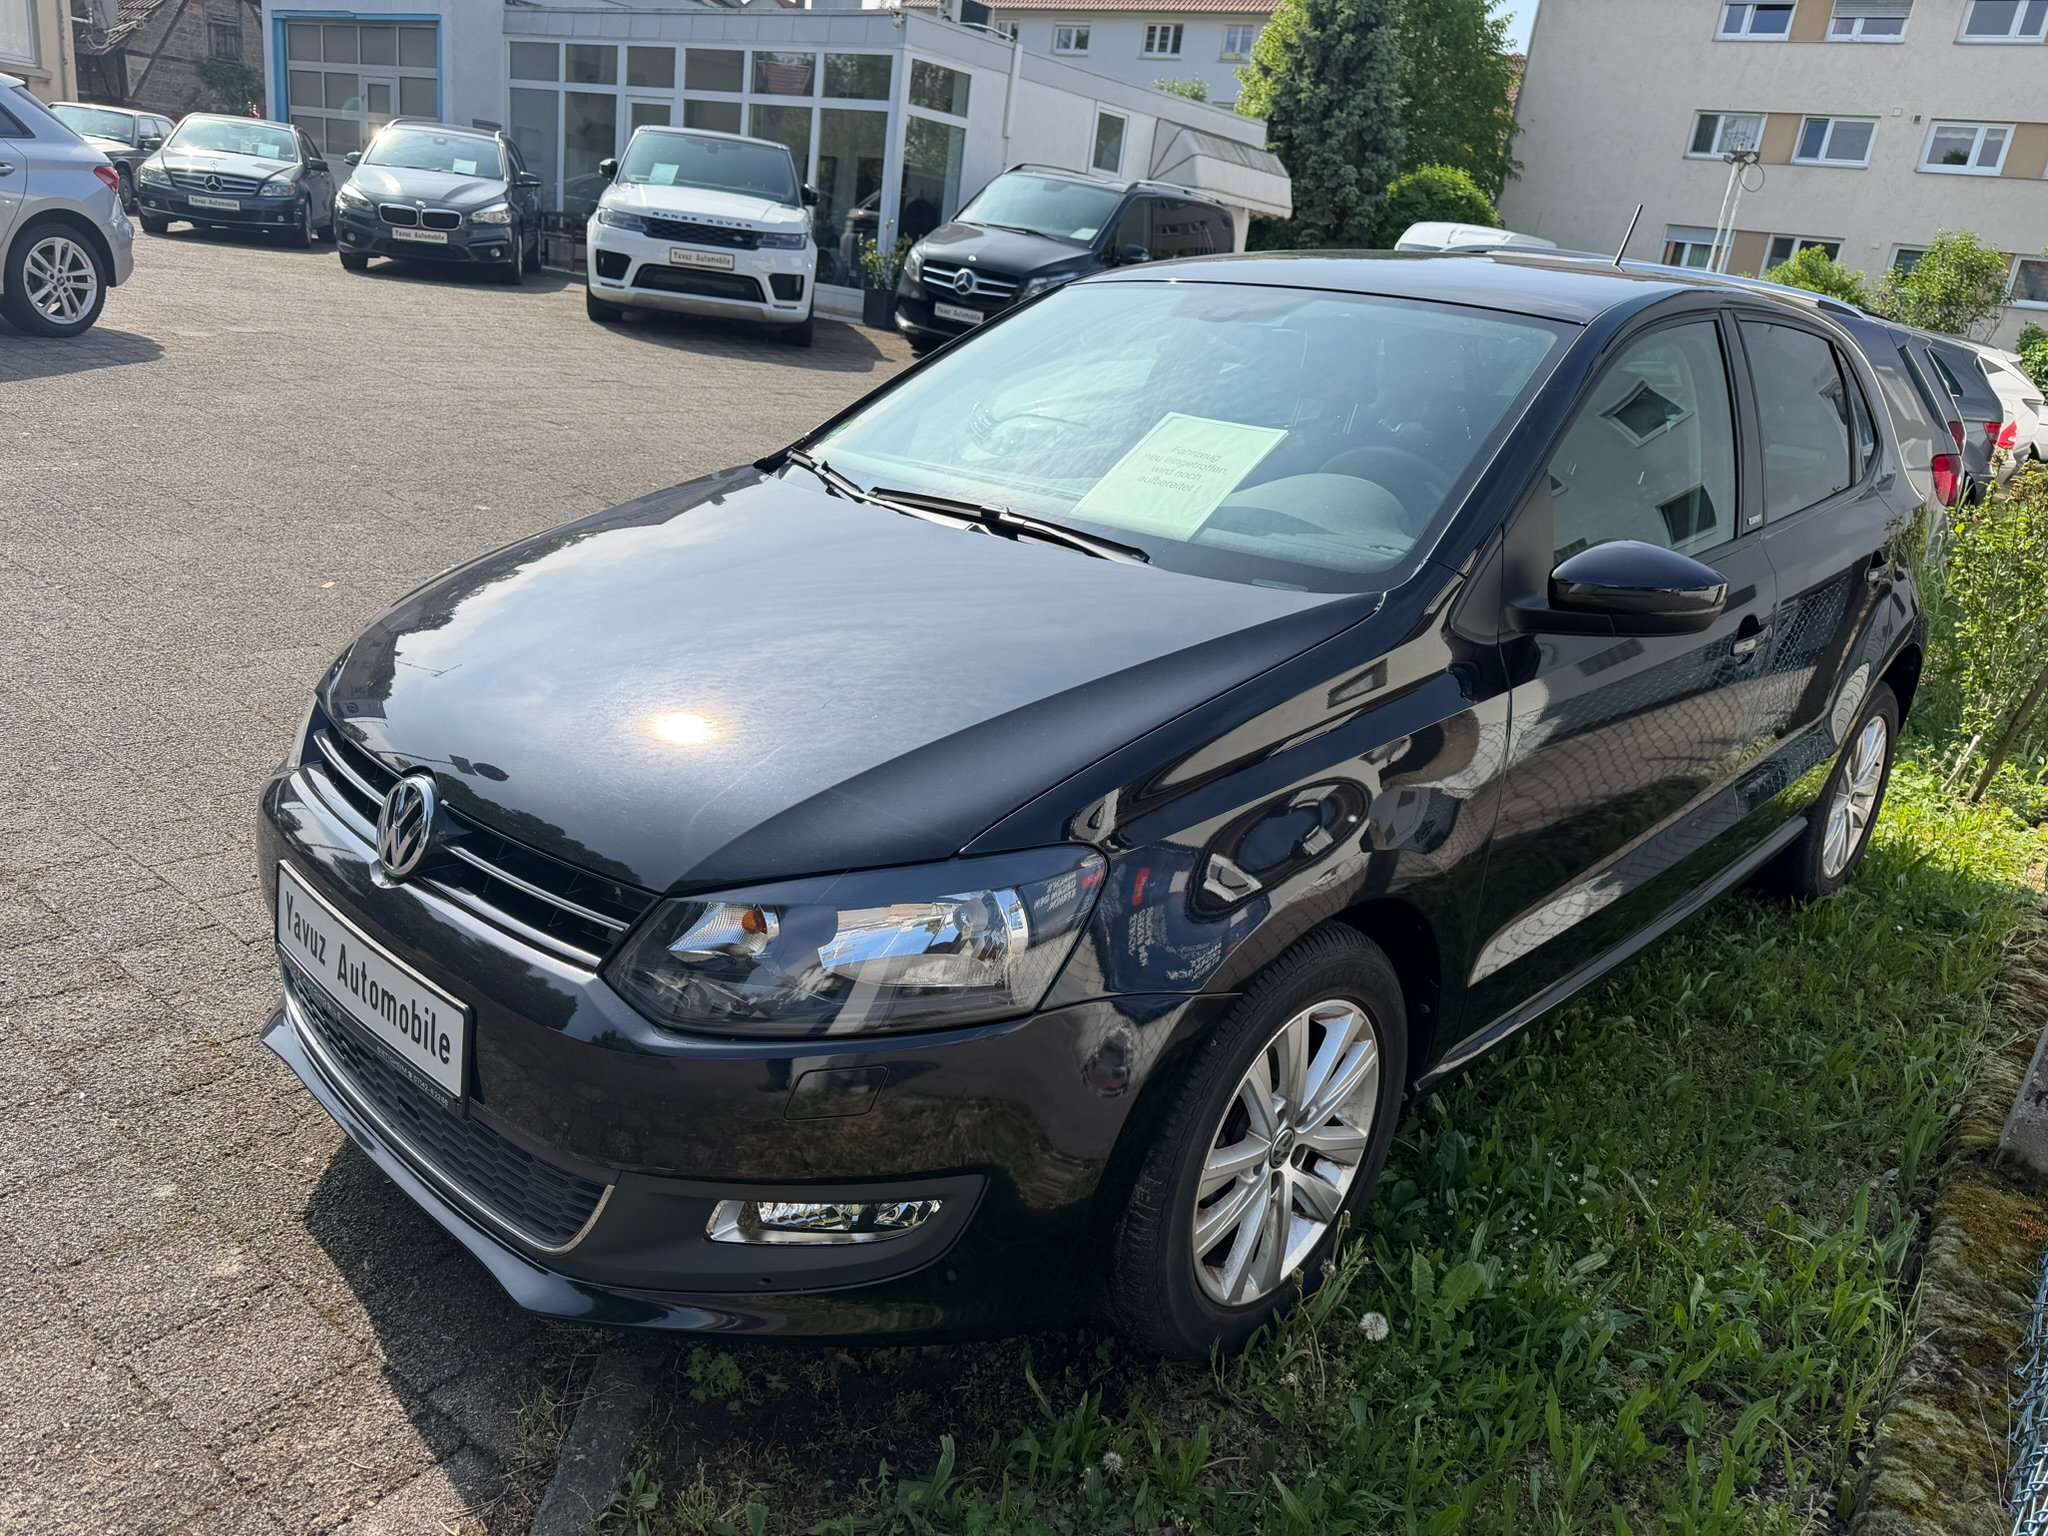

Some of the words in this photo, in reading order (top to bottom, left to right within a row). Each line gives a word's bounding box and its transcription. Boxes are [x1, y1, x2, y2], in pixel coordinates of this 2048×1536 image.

[652, 211, 698, 221] RANGE
[706, 218, 753, 228] ROVER
[673, 251, 692, 261] Yavuz
[696, 253, 731, 265] Automobile
[286, 890, 327, 967] Yavuz
[336, 943, 451, 1065] Automobile
